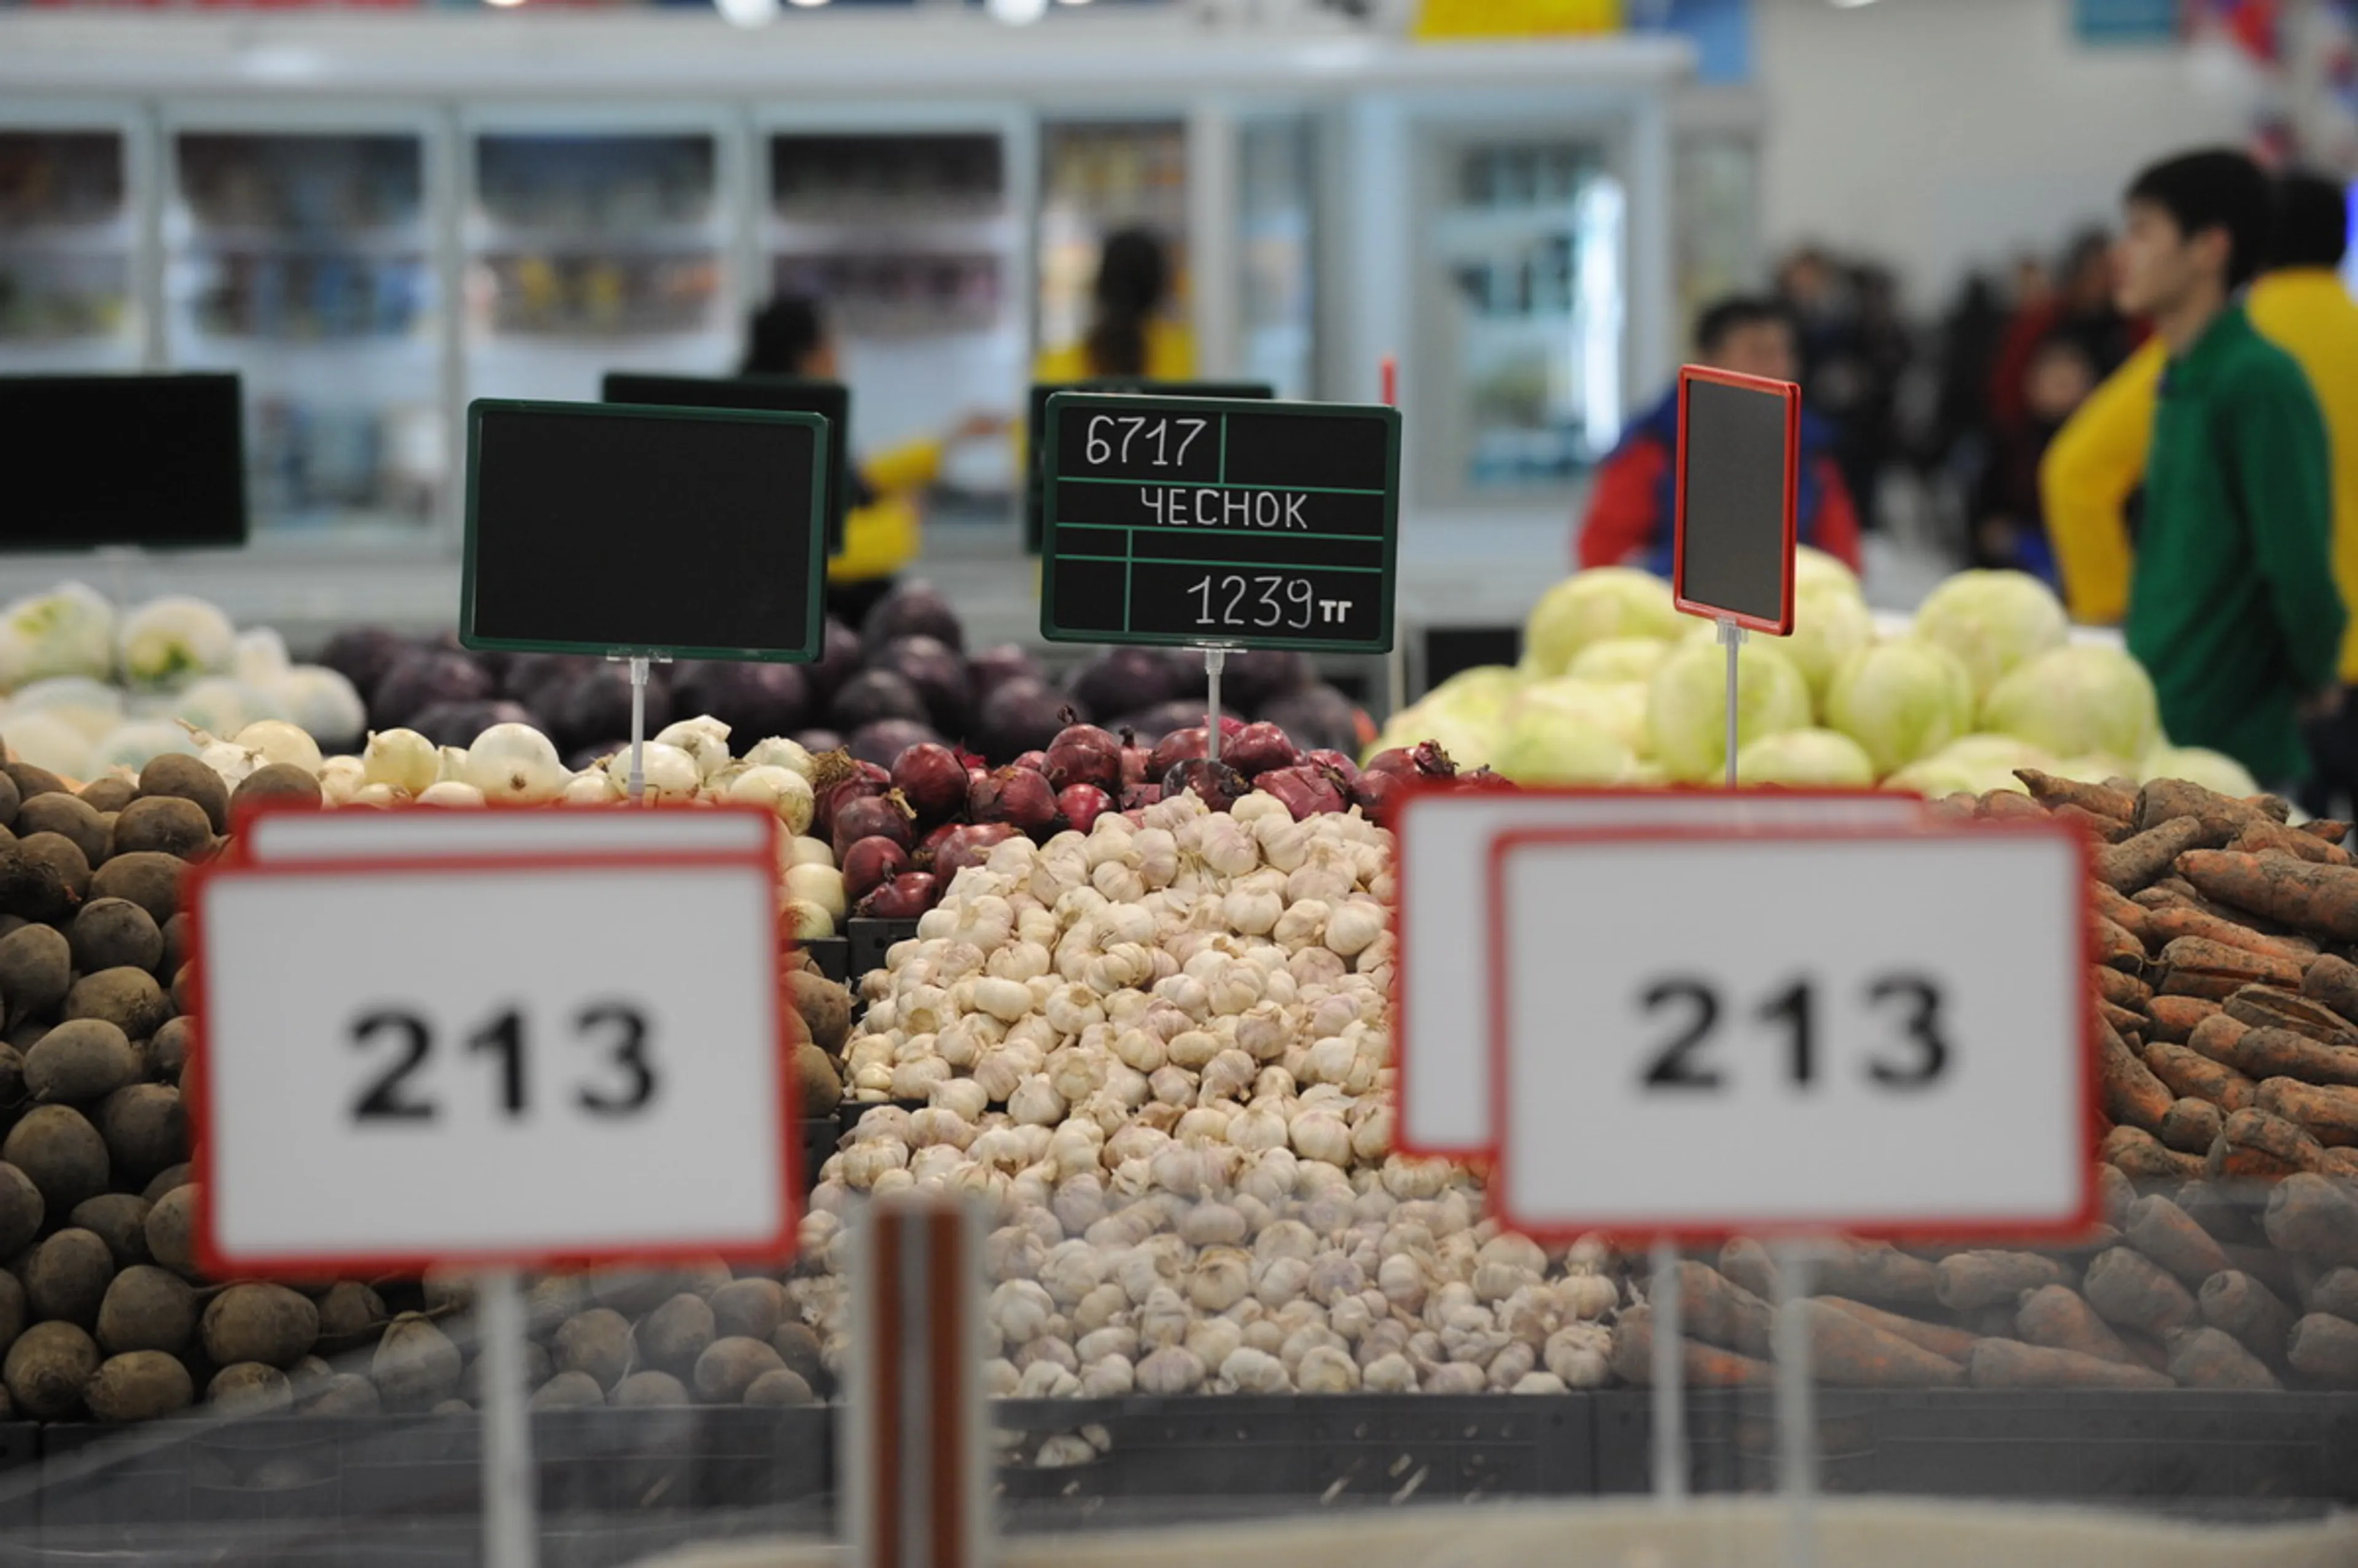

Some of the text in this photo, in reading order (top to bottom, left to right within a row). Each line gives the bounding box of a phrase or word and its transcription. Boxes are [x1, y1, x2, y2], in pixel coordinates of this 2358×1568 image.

[1086, 415, 1207, 466] 6717
[1140, 487, 1307, 529] ЧЕСНОК
[348, 1003, 661, 1126] 213
[1638, 974, 1954, 1093] 213
